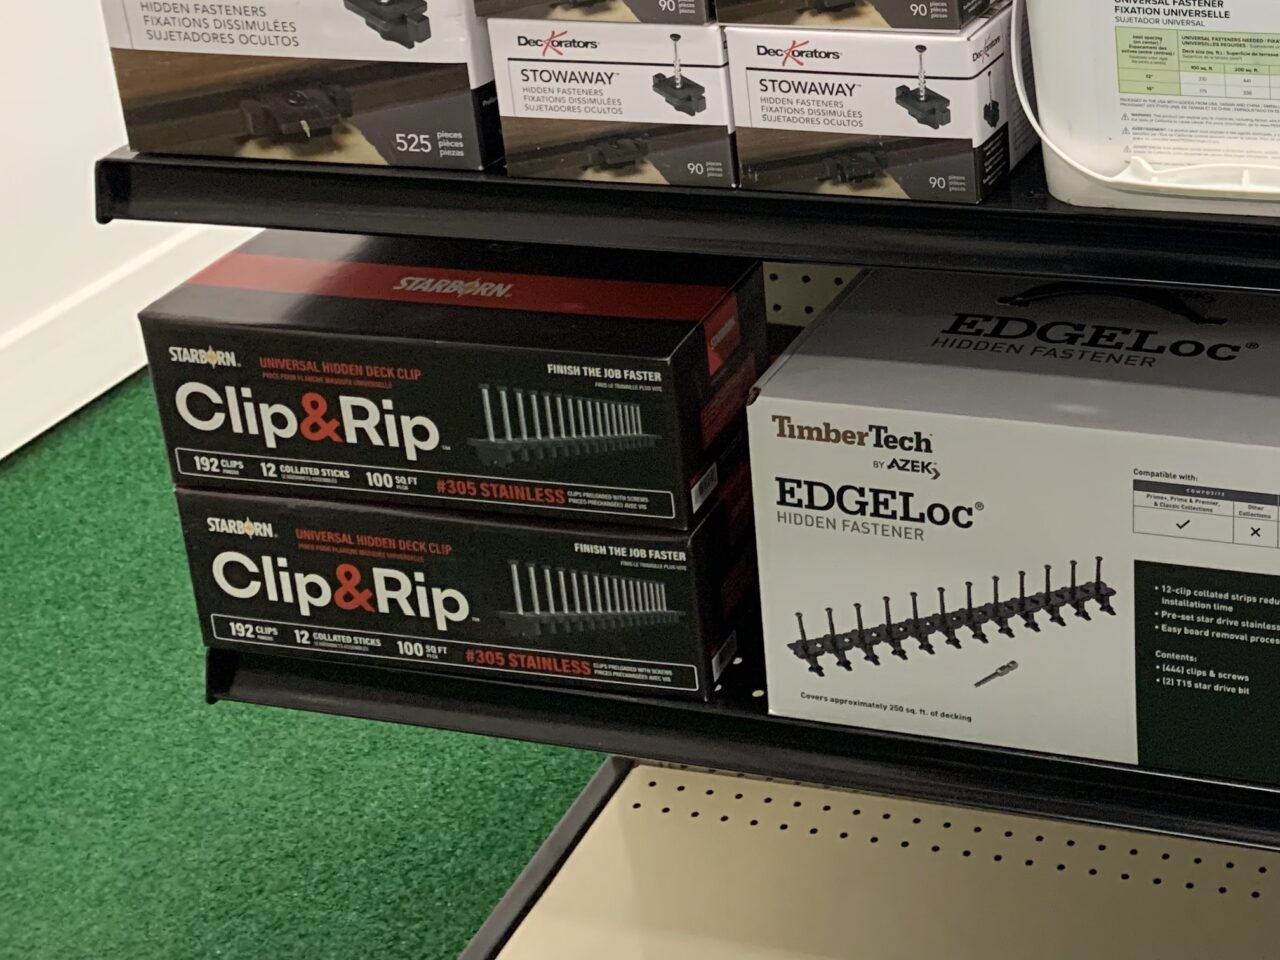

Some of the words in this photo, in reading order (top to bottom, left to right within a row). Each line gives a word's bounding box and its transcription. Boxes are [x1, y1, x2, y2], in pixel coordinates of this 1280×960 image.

[140, 2, 190, 14] HIDDEN
[194, 4, 266, 17] FASTENERS
[909, 3, 927, 17] 90
[1114, 6, 1158, 16] FIXATION
[1162, 7, 1230, 18] UNIVERSELLE
[143, 16, 210, 29] FIXATIONS
[213, 17, 296, 33] DISSIMULÉES
[1115, 16, 1160, 25] SUJETADOR
[1163, 18, 1205, 27] UNIVERSAL
[147, 30, 235, 45] SUJETADORES
[238, 33, 299, 47] OCULTOS
[762, 114, 820, 125] SUJETADORES
[823, 117, 864, 128] OCULTOS
[395, 133, 432, 152] 525
[394, 276, 513, 298] STARBORN
[168, 345, 241, 369] STARBORN
[932, 337, 1024, 356] HIDDEN
[1030, 346, 1156, 367] FASTENER
[259, 357, 318, 374] UNIVERSAL
[321, 361, 365, 377] HIDDEN
[368, 364, 394, 379] DECK
[397, 366, 421, 381] CLIP
[547, 363, 580, 378] FINISH
[582, 366, 601, 379] THE
[603, 367, 622, 380] JOB
[624, 369, 661, 383] FASTER
[772, 416, 933, 454] TimberTech
[194, 455, 220, 473] 192
[221, 458, 244, 470] CLIPS
[260, 462, 277, 478] 12
[280, 464, 319, 478] COLLATED
[321, 467, 349, 479] STICKS
[366, 471, 393, 489] 100
[873, 460, 884, 468] BY
[887, 458, 940, 479] AZEK
[207, 517, 277, 539] STARBORN
[777, 512, 837, 533] HIDDEN
[842, 519, 924, 542] FASTENER
[1162, 584, 1191, 598] 12-clip
[1194, 587, 1229, 600] collated
[1231, 592, 1256, 605] strips
[1162, 596, 1211, 611] installation
[1213, 602, 1234, 612] time
[1161, 609, 1193, 621] Pre-set
[1196, 613, 1212, 623] star
[1216, 614, 1238, 625] drive
[1241, 616, 1280, 630] stainless
[465, 648, 504, 666] #305
[508, 653, 591, 676] STAINLESS
[801, 692, 828, 703] Covers
[830, 696, 887, 712] approximately
[889, 703, 904, 713] 250
